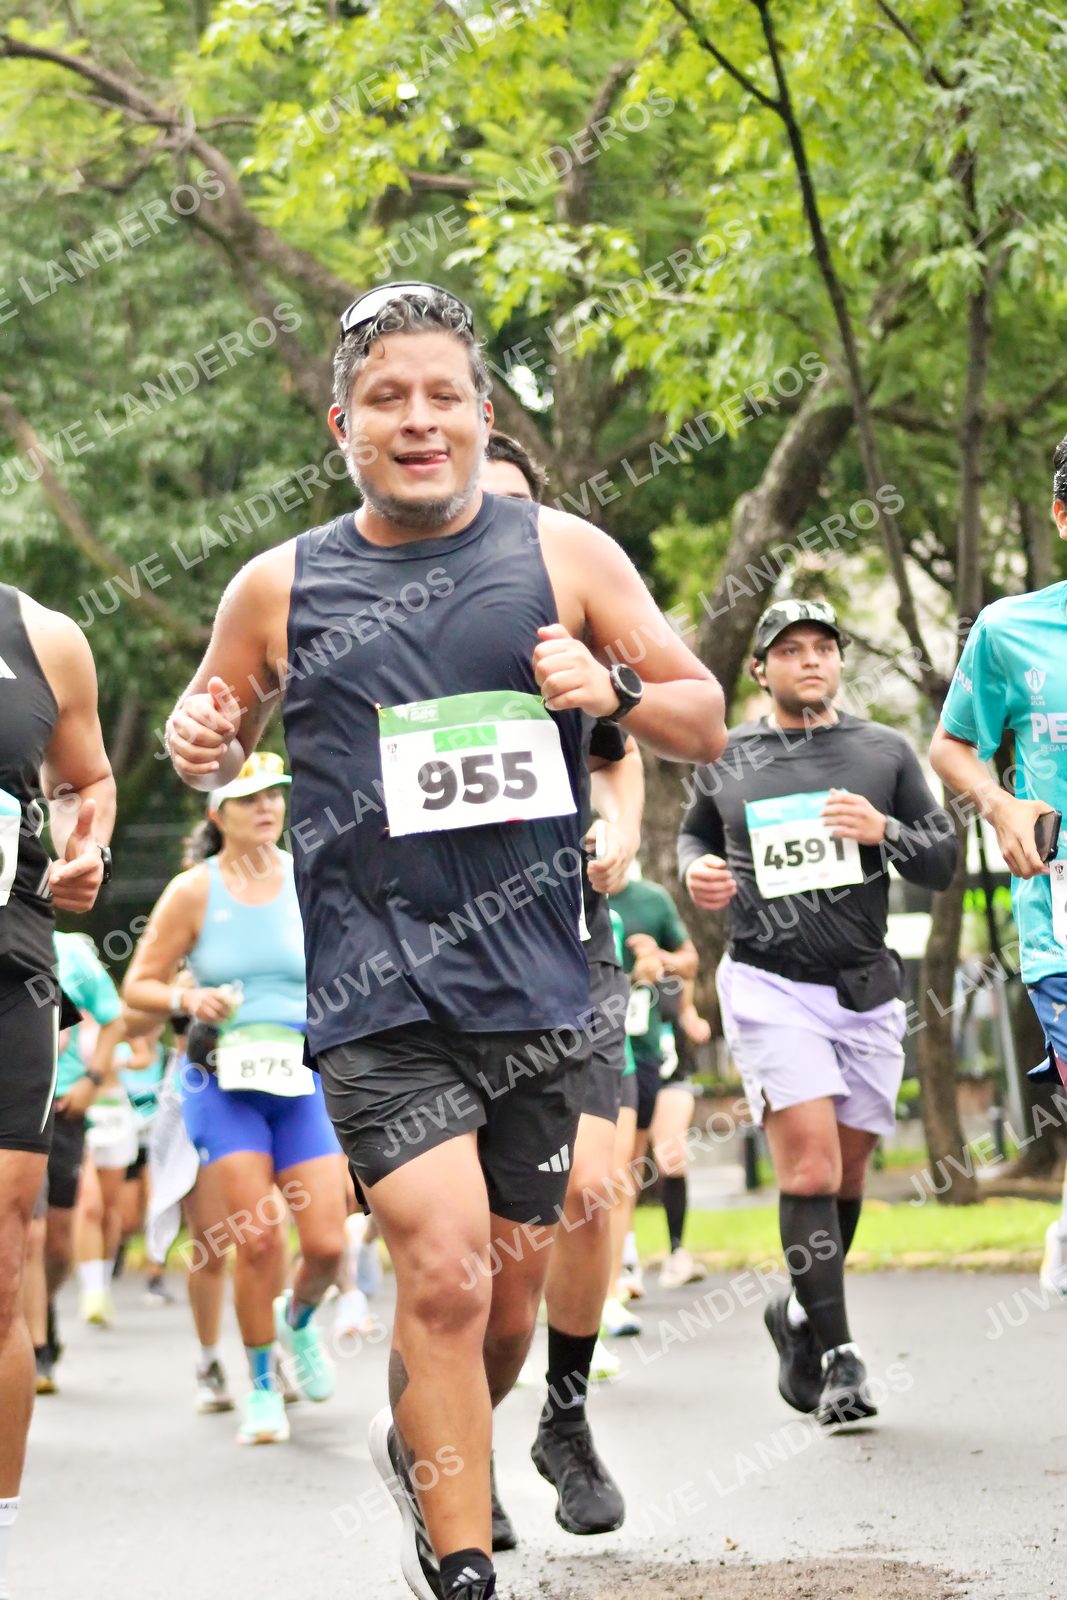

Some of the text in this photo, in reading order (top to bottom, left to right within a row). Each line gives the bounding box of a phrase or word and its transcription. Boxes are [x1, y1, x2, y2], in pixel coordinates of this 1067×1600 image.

[1031, 712, 1067, 743] PE
[417, 751, 538, 811] 955
[764, 836, 845, 870] 4591
[241, 1058, 294, 1078] 875
